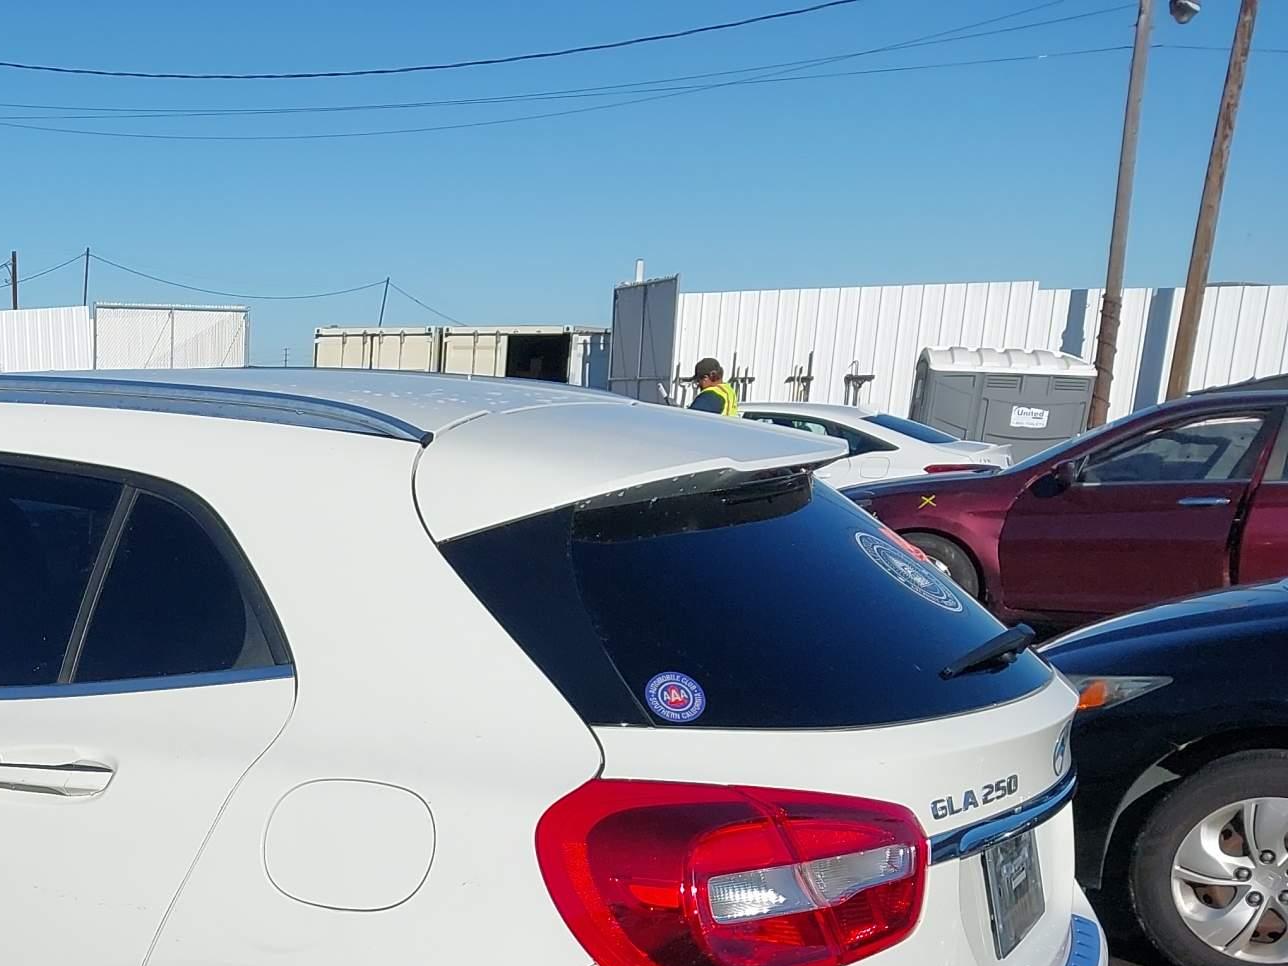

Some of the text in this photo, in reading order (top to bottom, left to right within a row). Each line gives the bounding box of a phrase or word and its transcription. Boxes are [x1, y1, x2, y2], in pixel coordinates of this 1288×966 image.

[1017, 408, 1044, 418] United
[681, 676, 697, 692] CLUB
[663, 688, 689, 702] AAA
[930, 774, 1019, 820] GLA 250
